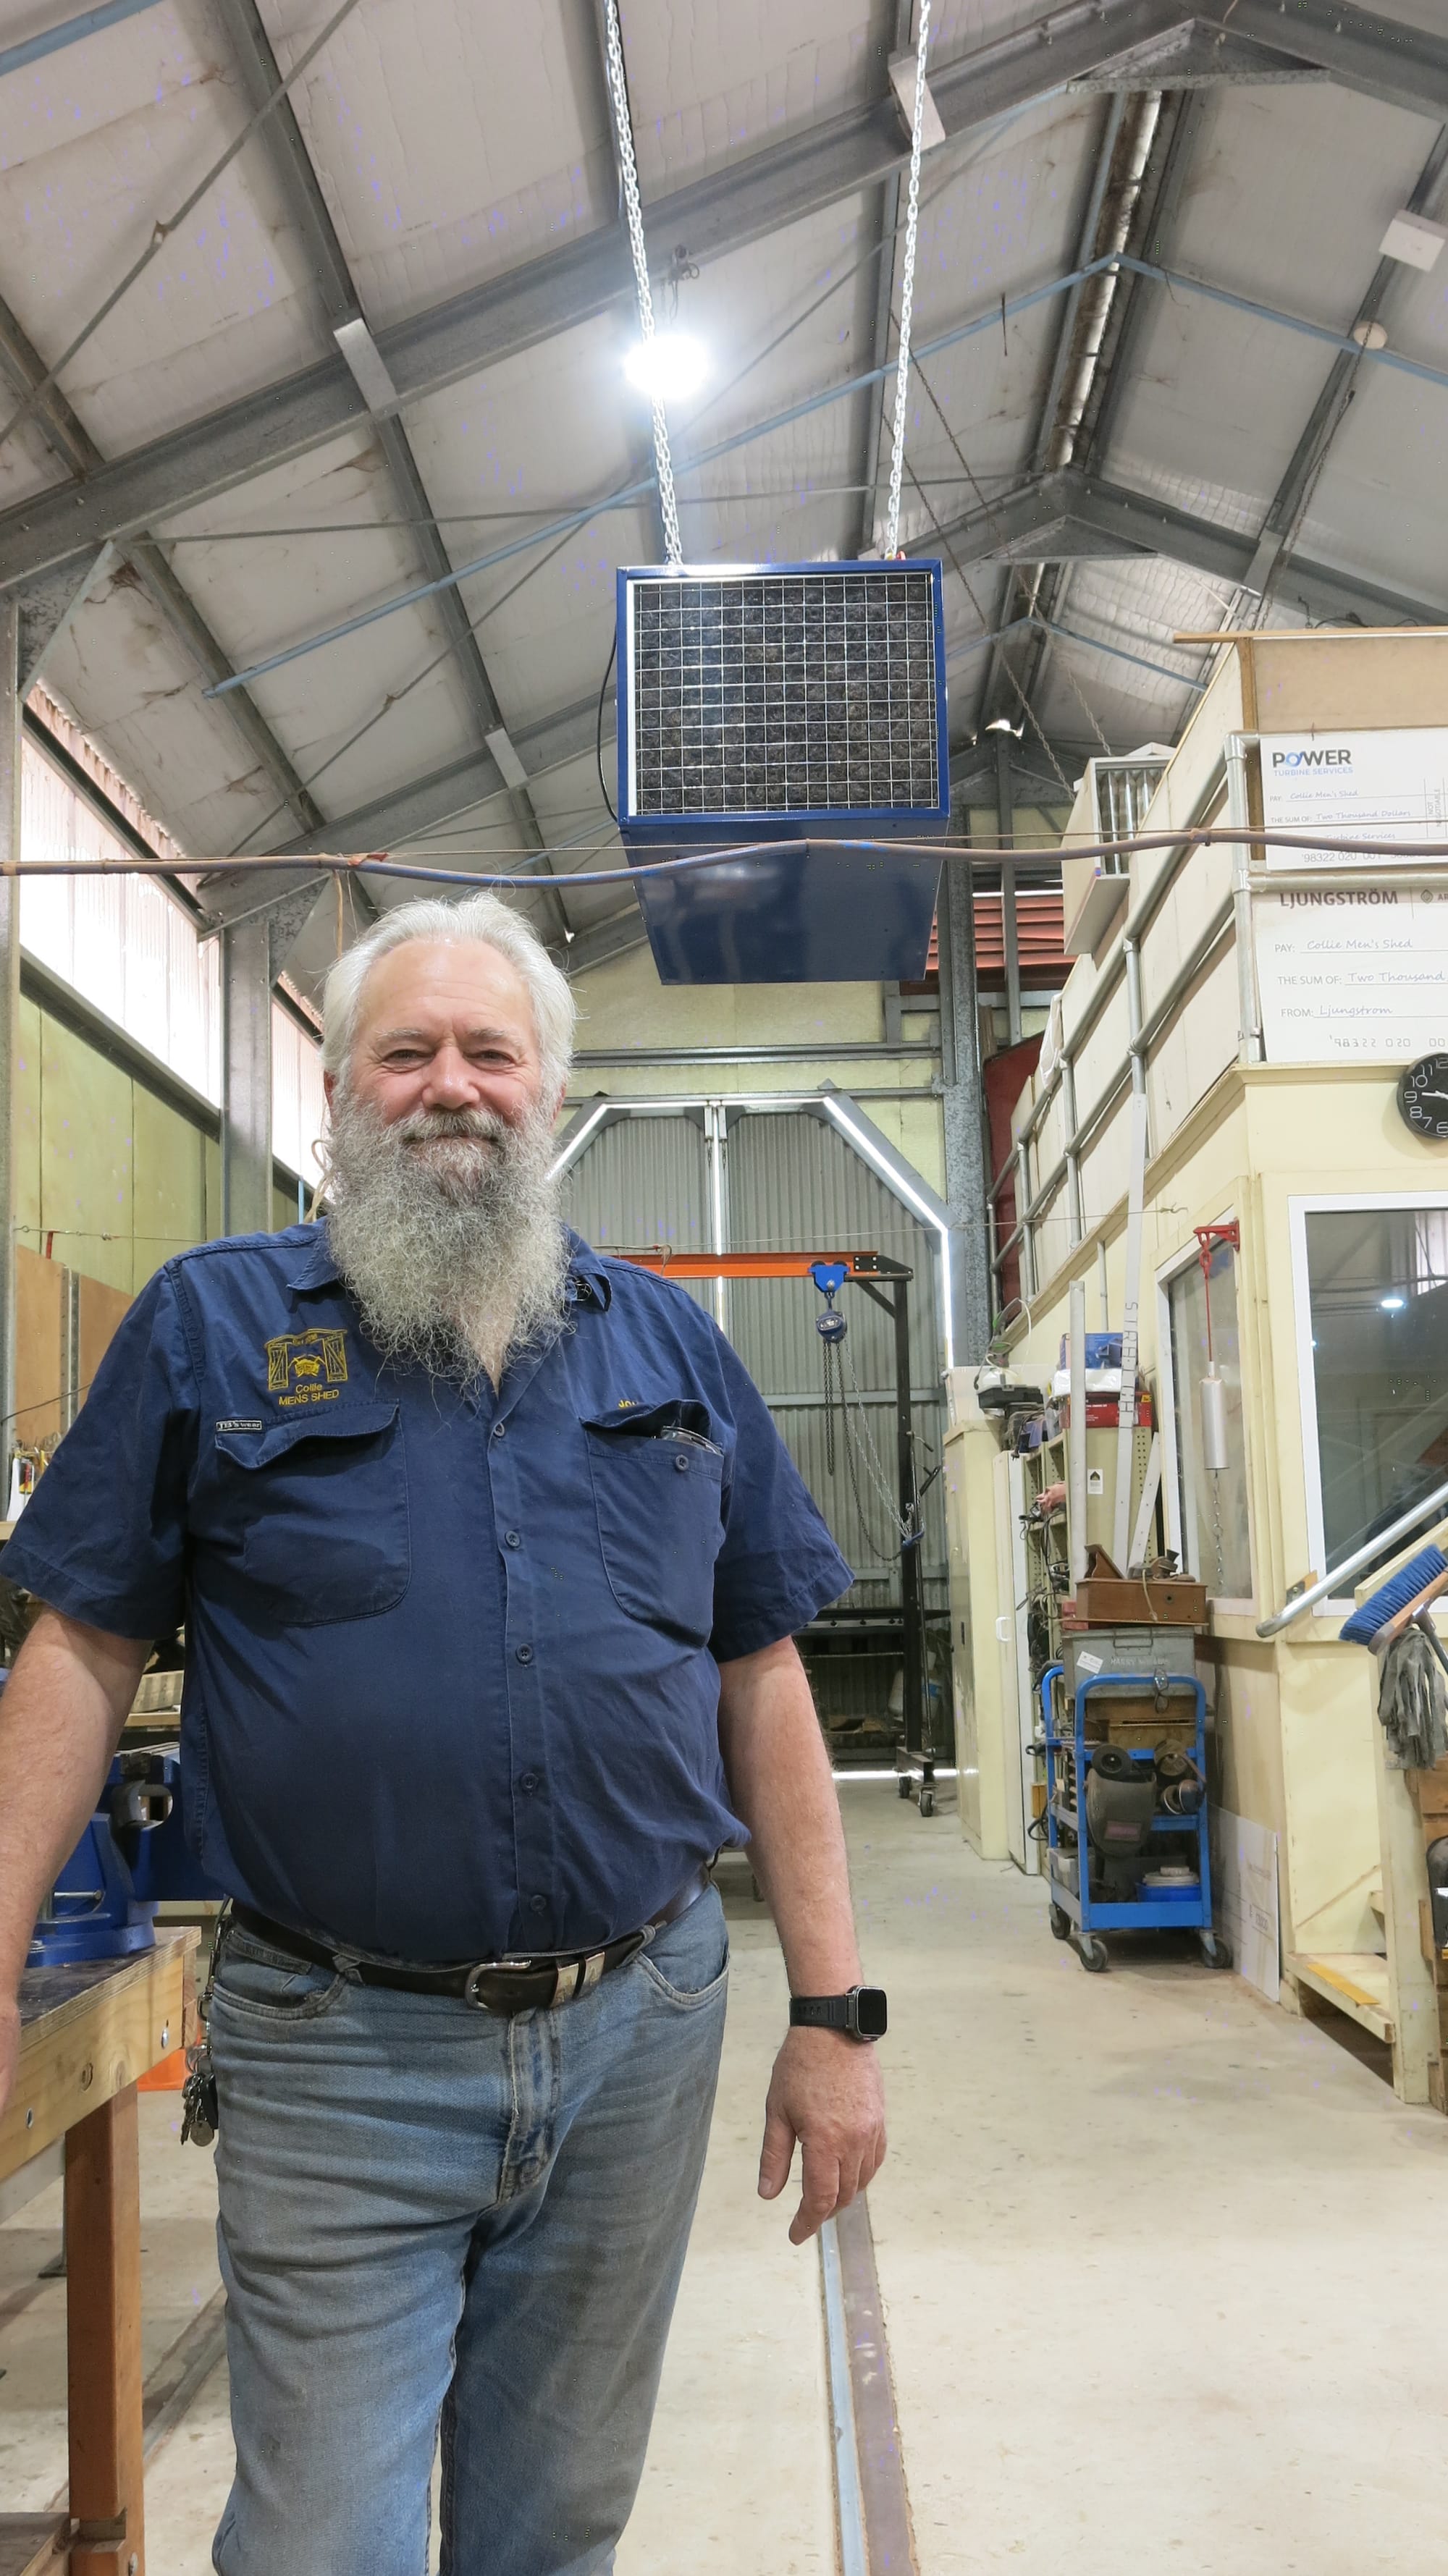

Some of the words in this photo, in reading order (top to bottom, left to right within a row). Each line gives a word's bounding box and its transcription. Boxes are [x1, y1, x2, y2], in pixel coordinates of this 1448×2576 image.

[1272, 749, 1352, 767] POWER
[1313, 767, 1353, 775] SERVICES
[1336, 811, 1379, 819] Thousand
[1381, 808, 1412, 817] Dollars
[1279, 889, 1399, 908] LJUNGSTRÖM
[1274, 944, 1295, 953] PAY:
[1307, 939, 1342, 950] Collie
[1346, 939, 1379, 950] Men's
[1383, 938, 1413, 949] Shed
[1278, 976, 1297, 985] THE
[1300, 976, 1323, 985] SUM
[1325, 975, 1342, 985] OF:
[1347, 972, 1374, 983] Two
[1378, 971, 1444, 982] Thousand
[1281, 1008, 1313, 1018] FROM:
[1320, 1005, 1394, 1018] Ljungstrom
[1420, 1064, 1433, 1076] 11
[1410, 1075, 1428, 1088] 10
[1404, 1091, 1418, 1103] 9
[1410, 1106, 1423, 1119] 8
[1422, 1116, 1433, 1129] 7
[1436, 1121, 1448, 1134] 6
[295, 1383, 322, 1394] Collie
[279, 1393, 309, 1406] MENS
[311, 1389, 340, 1402] SHED
